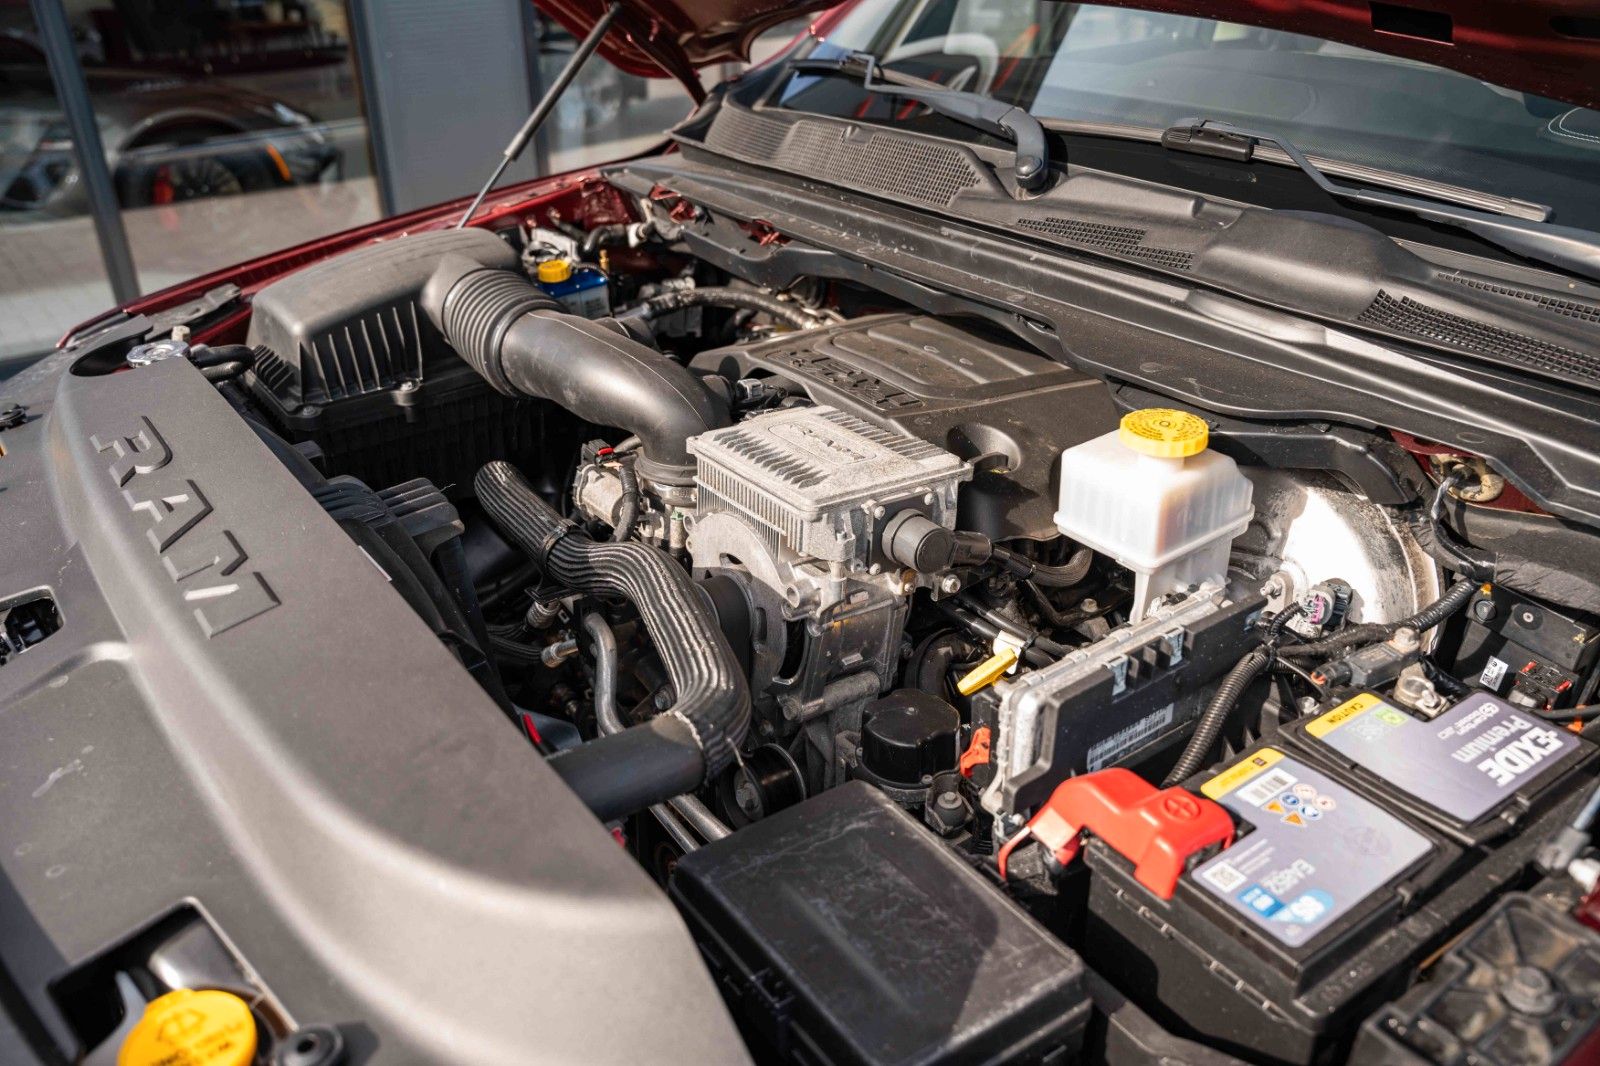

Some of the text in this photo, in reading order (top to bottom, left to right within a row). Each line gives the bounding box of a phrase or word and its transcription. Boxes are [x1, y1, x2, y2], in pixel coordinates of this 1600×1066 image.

[90, 416, 281, 639] RAM
[1327, 702, 1364, 724] CAUTION
[1451, 714, 1533, 763] Premium
[1477, 727, 1564, 787] EXIDE
